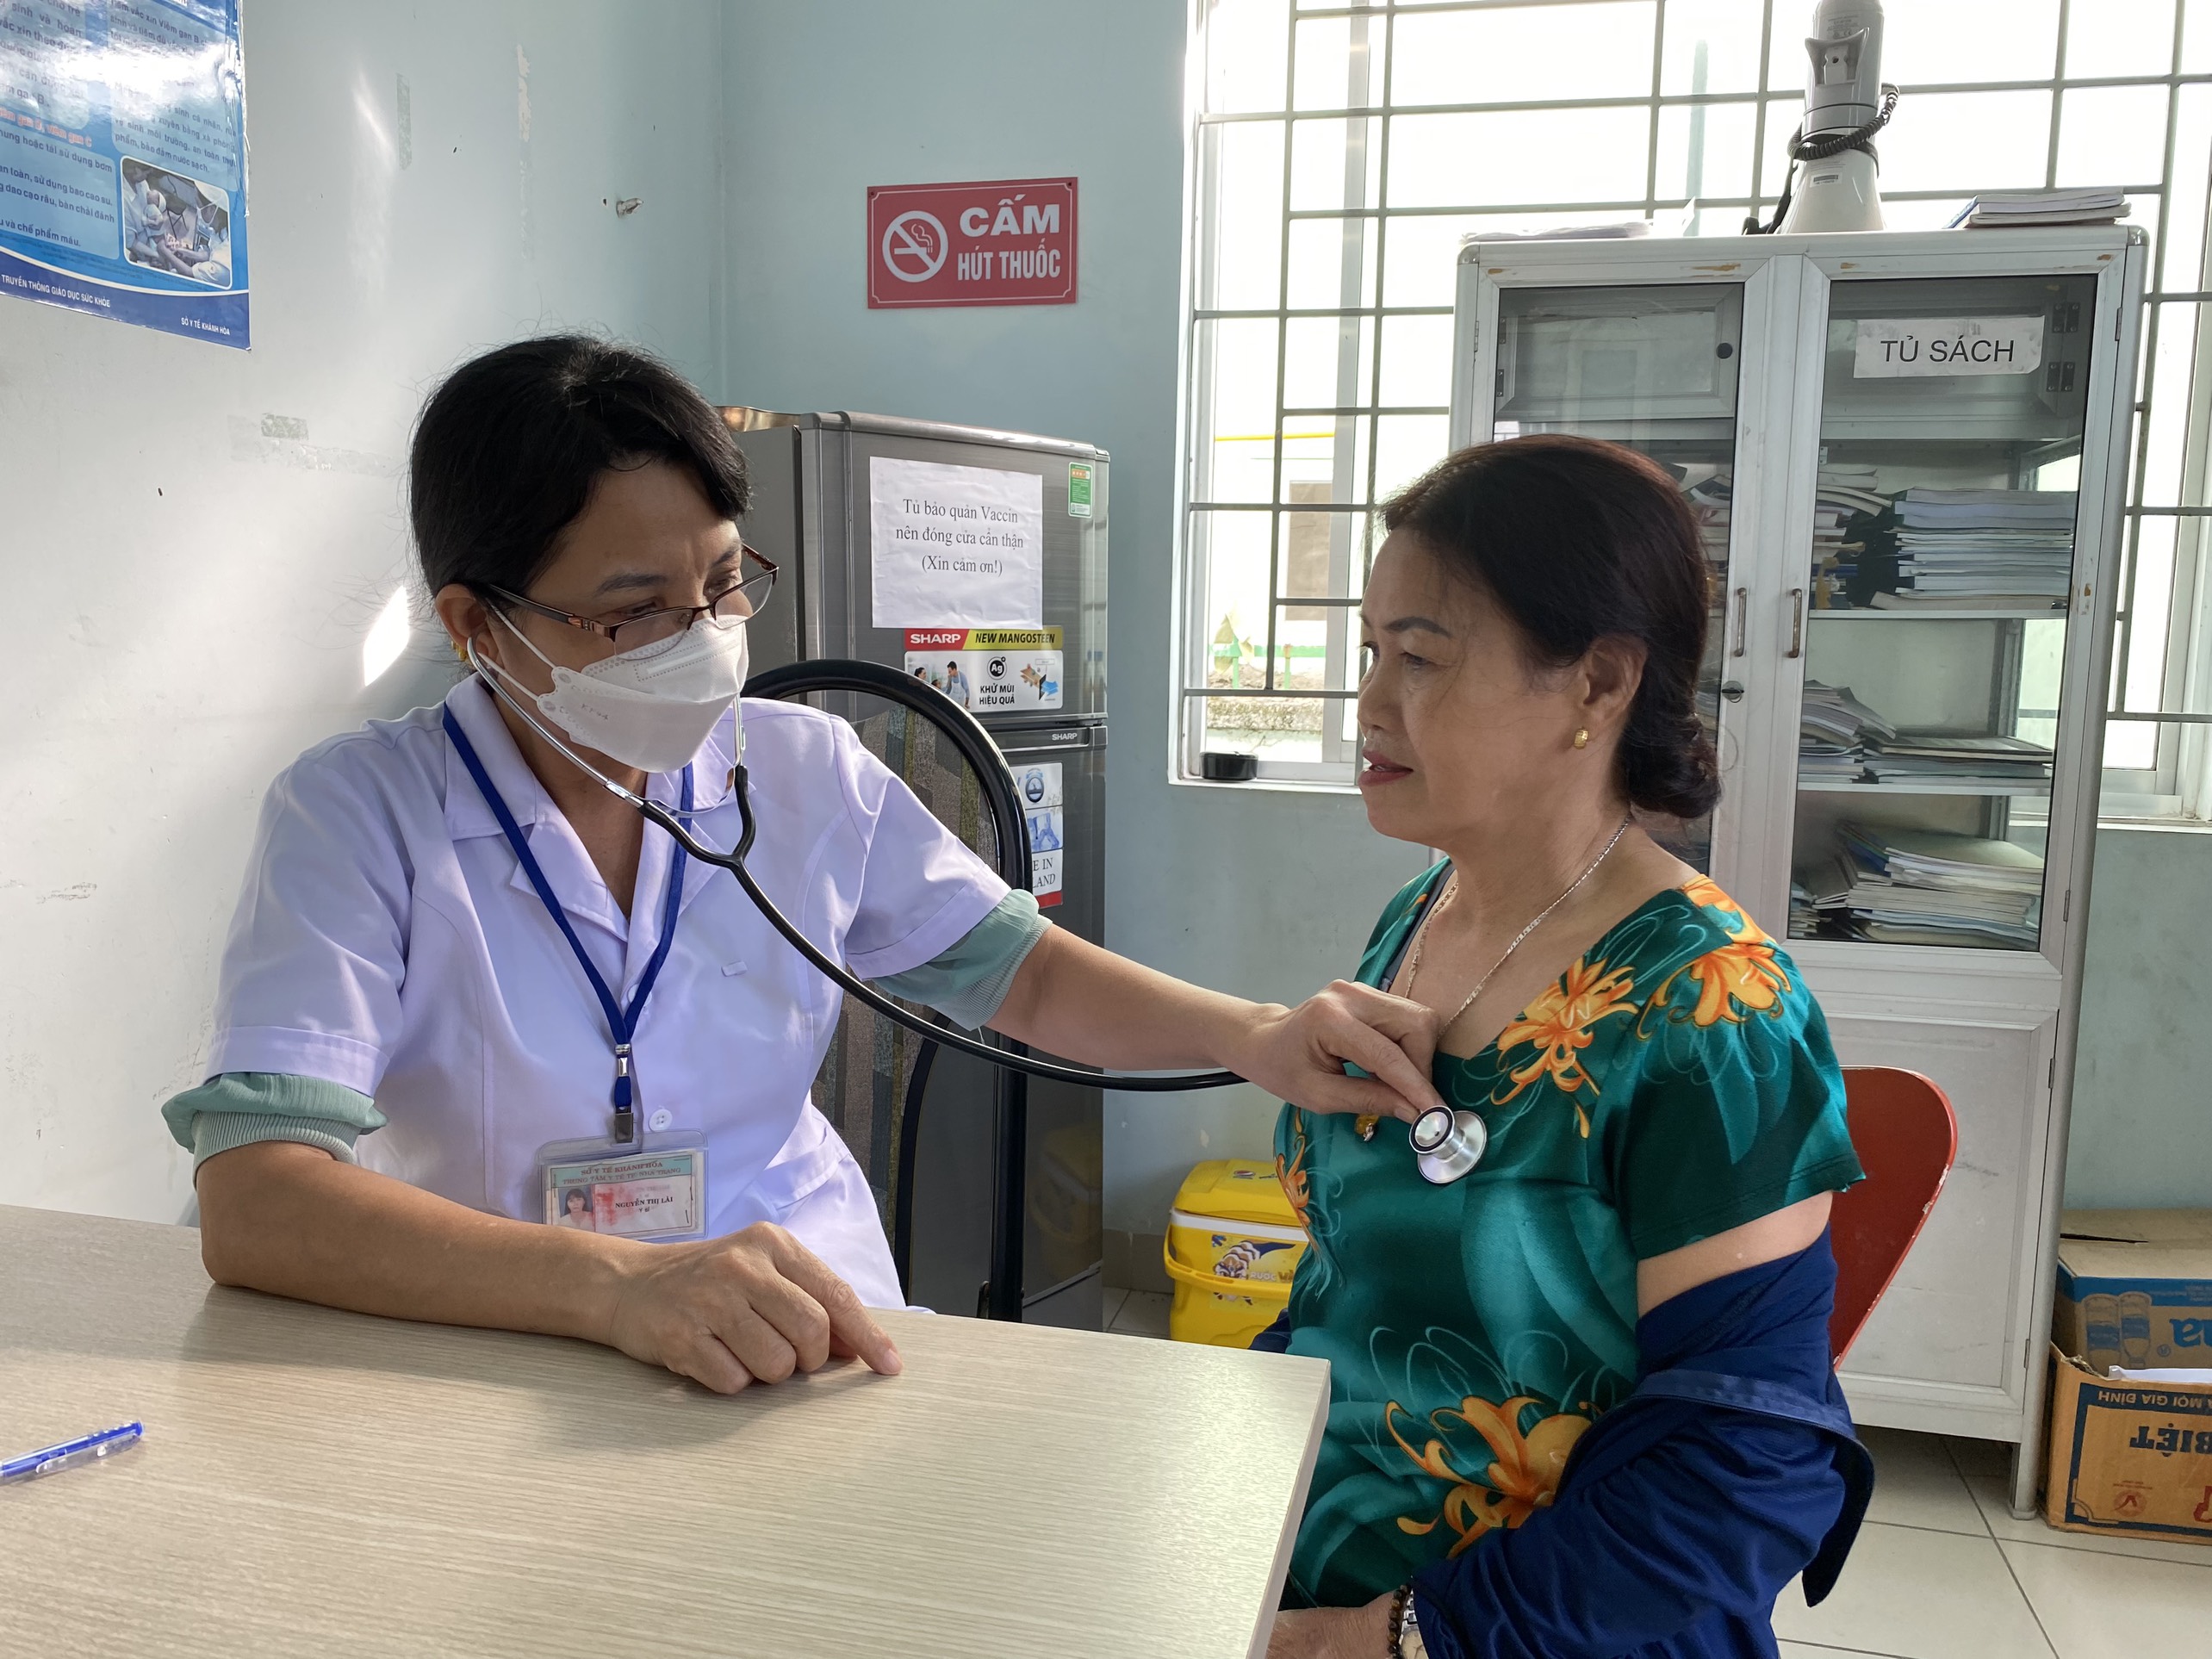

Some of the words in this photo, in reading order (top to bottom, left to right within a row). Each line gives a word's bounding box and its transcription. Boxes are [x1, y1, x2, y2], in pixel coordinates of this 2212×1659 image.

[178, 29, 192, 40] gan
[5, 183, 22, 196] dao
[46, 178, 68, 195] dụng
[69, 184, 84, 197] bao
[86, 190, 101, 202] cao
[959, 193, 1060, 238] CẤM
[5, 219, 16, 230] và
[17, 221, 34, 235] chế
[957, 245, 994, 281] HÚT
[998, 237, 1061, 280] THUỐC
[1, 274, 28, 289] TRUYỀN
[28, 280, 51, 295] THÔNG
[190, 319, 194, 327] Y
[1880, 335, 1920, 363] TỦ
[1929, 334, 2015, 363] SÁCH
[903, 498, 920, 515] Tủ
[924, 500, 946, 517] bảo
[949, 504, 978, 522] quản
[980, 506, 1019, 524] Vaccin
[896, 525, 919, 541] nên
[922, 526, 953, 547] đóng
[955, 529, 977, 545] cửa
[979, 526, 999, 547] cẩn
[1002, 533, 1024, 551] thận
[922, 554, 949, 574] (Xin
[953, 557, 977, 573] cảm
[979, 559, 1003, 578] ơn!)
[910, 633, 961, 644] SHARP
[975, 633, 997, 644] NEW
[998, 633, 1056, 644] MANGOSTEEN
[979, 681, 998, 694] KHỬ
[979, 695, 997, 708] HIỆU
[1052, 732, 1078, 742] SHARP
[1042, 857, 1053, 870] IN
[2097, 1389, 2137, 1405] ĐÌNH
[2141, 1393, 2169, 1407] GIA
[2172, 1394, 2203, 1409] MỌI
[2128, 1422, 2212, 1457] BIỆT
